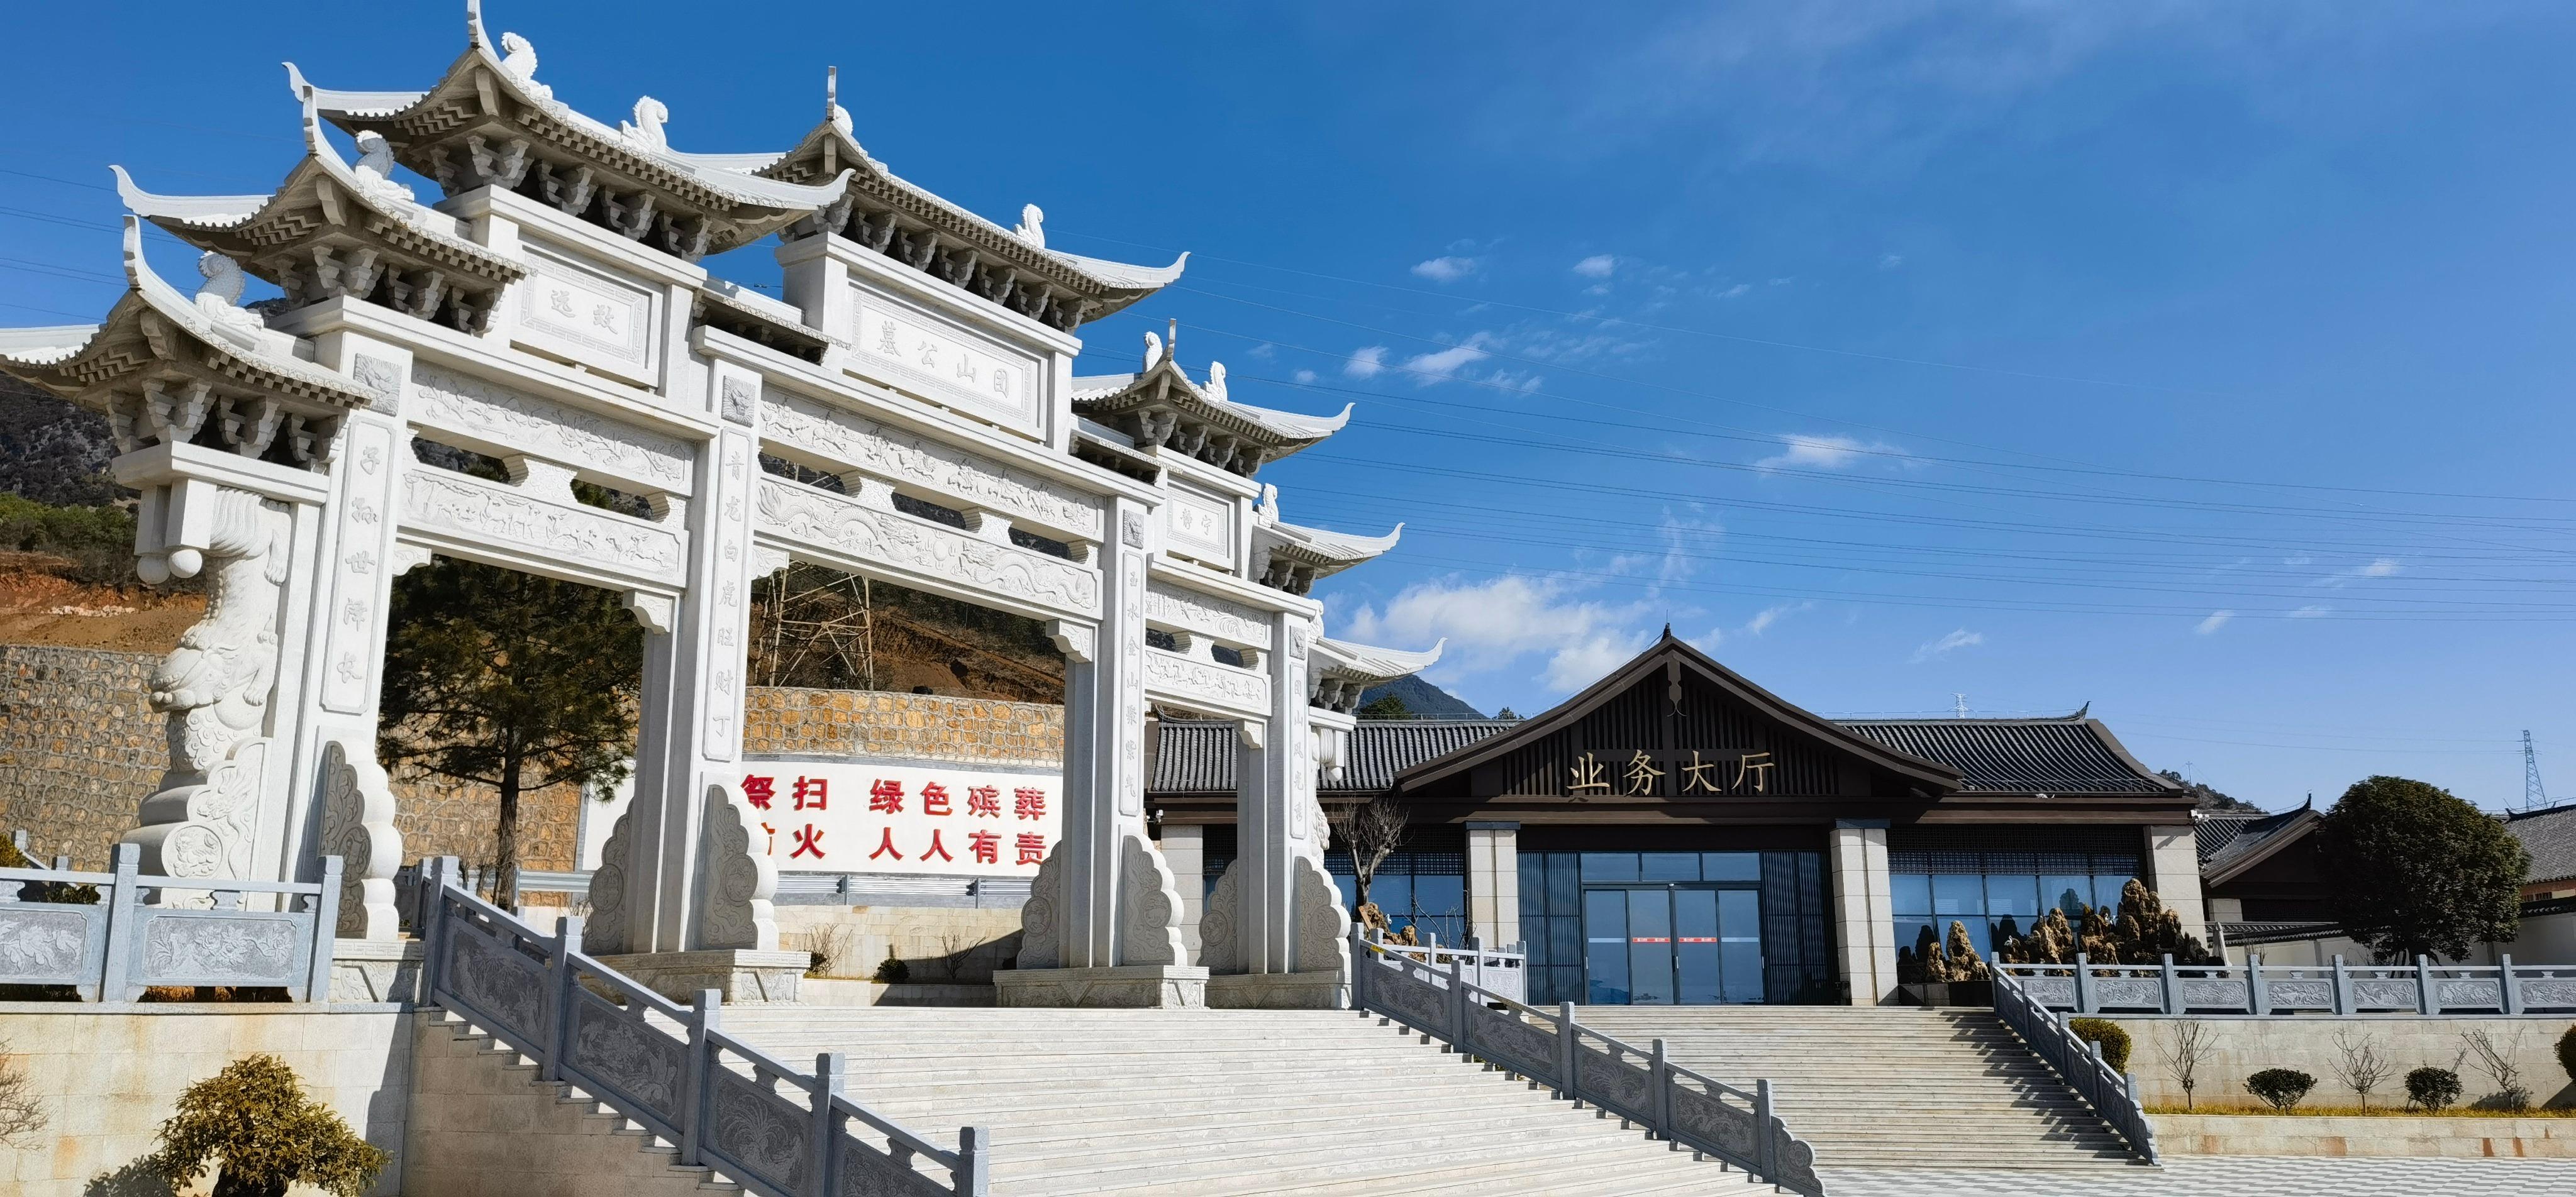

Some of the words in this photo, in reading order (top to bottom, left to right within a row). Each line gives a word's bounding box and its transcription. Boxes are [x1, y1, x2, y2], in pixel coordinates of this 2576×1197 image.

[712, 451, 745, 737] 青龙白虎旺财丁
[1565, 748, 1775, 797] 业务大厅
[740, 774, 828, 811] 祭扫
[869, 778, 1046, 821] 绿色殡葬
[761, 822, 826, 860] 火
[868, 826, 1047, 866] 人人有责
